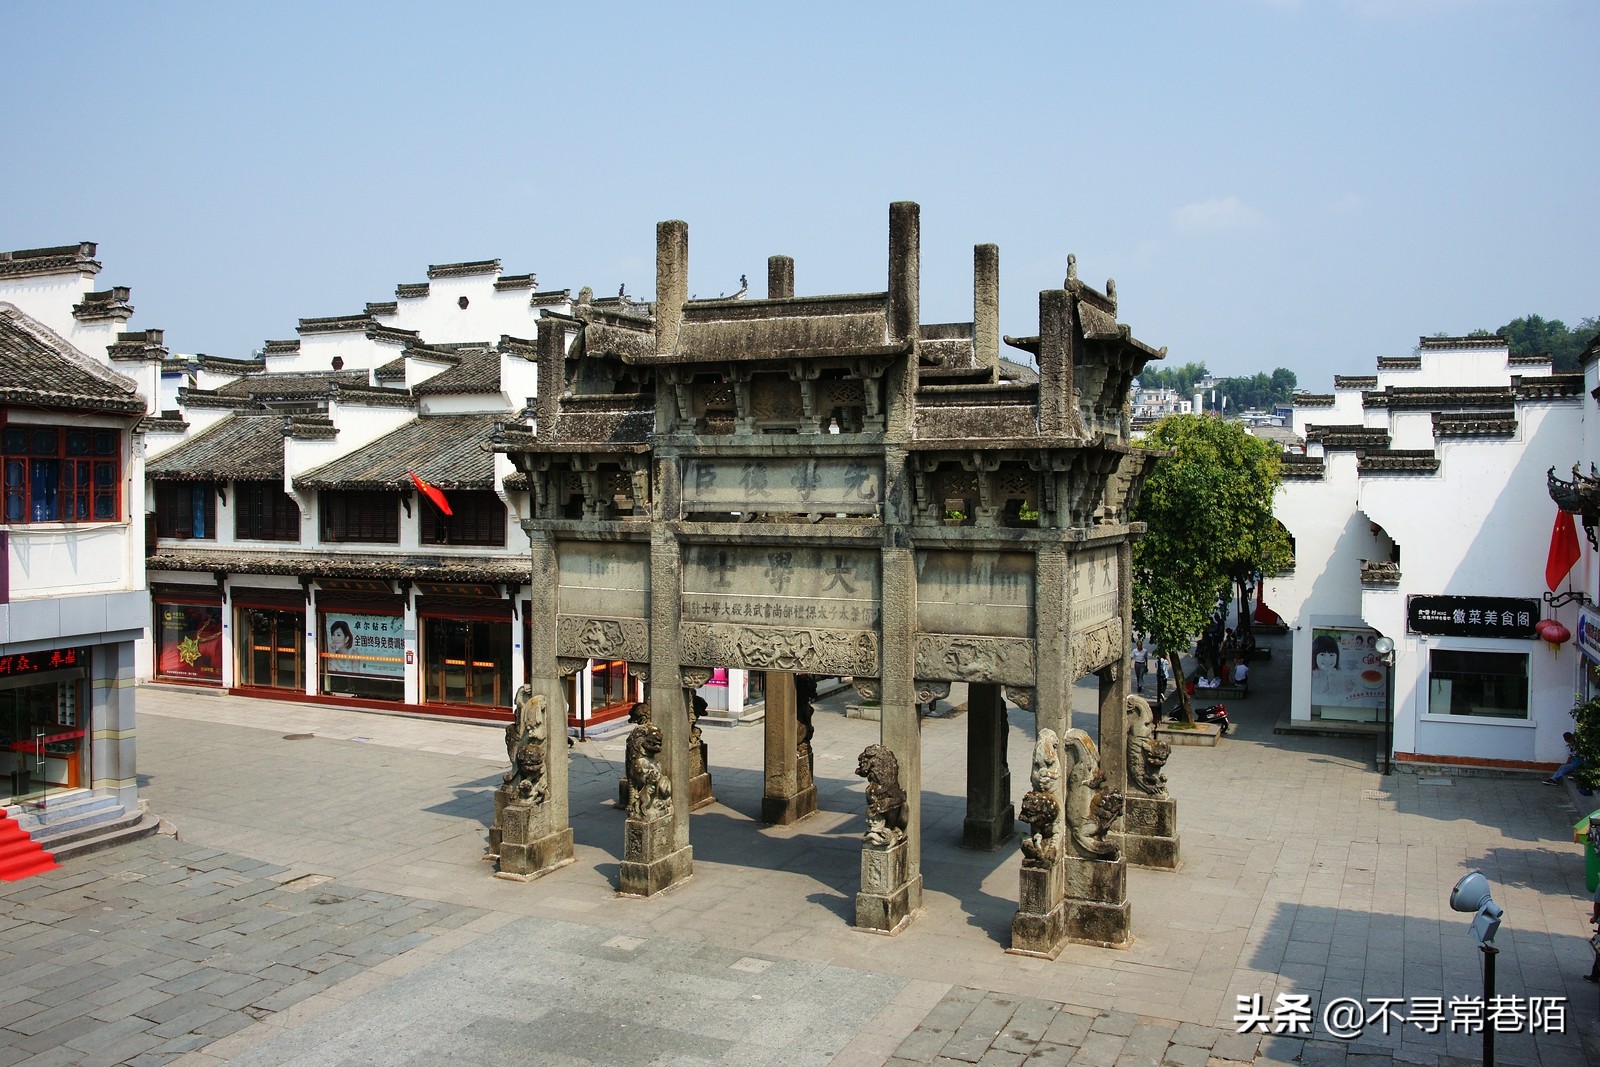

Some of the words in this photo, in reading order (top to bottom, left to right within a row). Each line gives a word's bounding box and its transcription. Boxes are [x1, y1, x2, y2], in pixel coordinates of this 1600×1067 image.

[706, 550, 858, 594] 大學士
[1073, 551, 1112, 596] 大學士
[354, 621, 388, 631] 卓尔钻石
[1453, 608, 1530, 627] 徽菜美食阁
